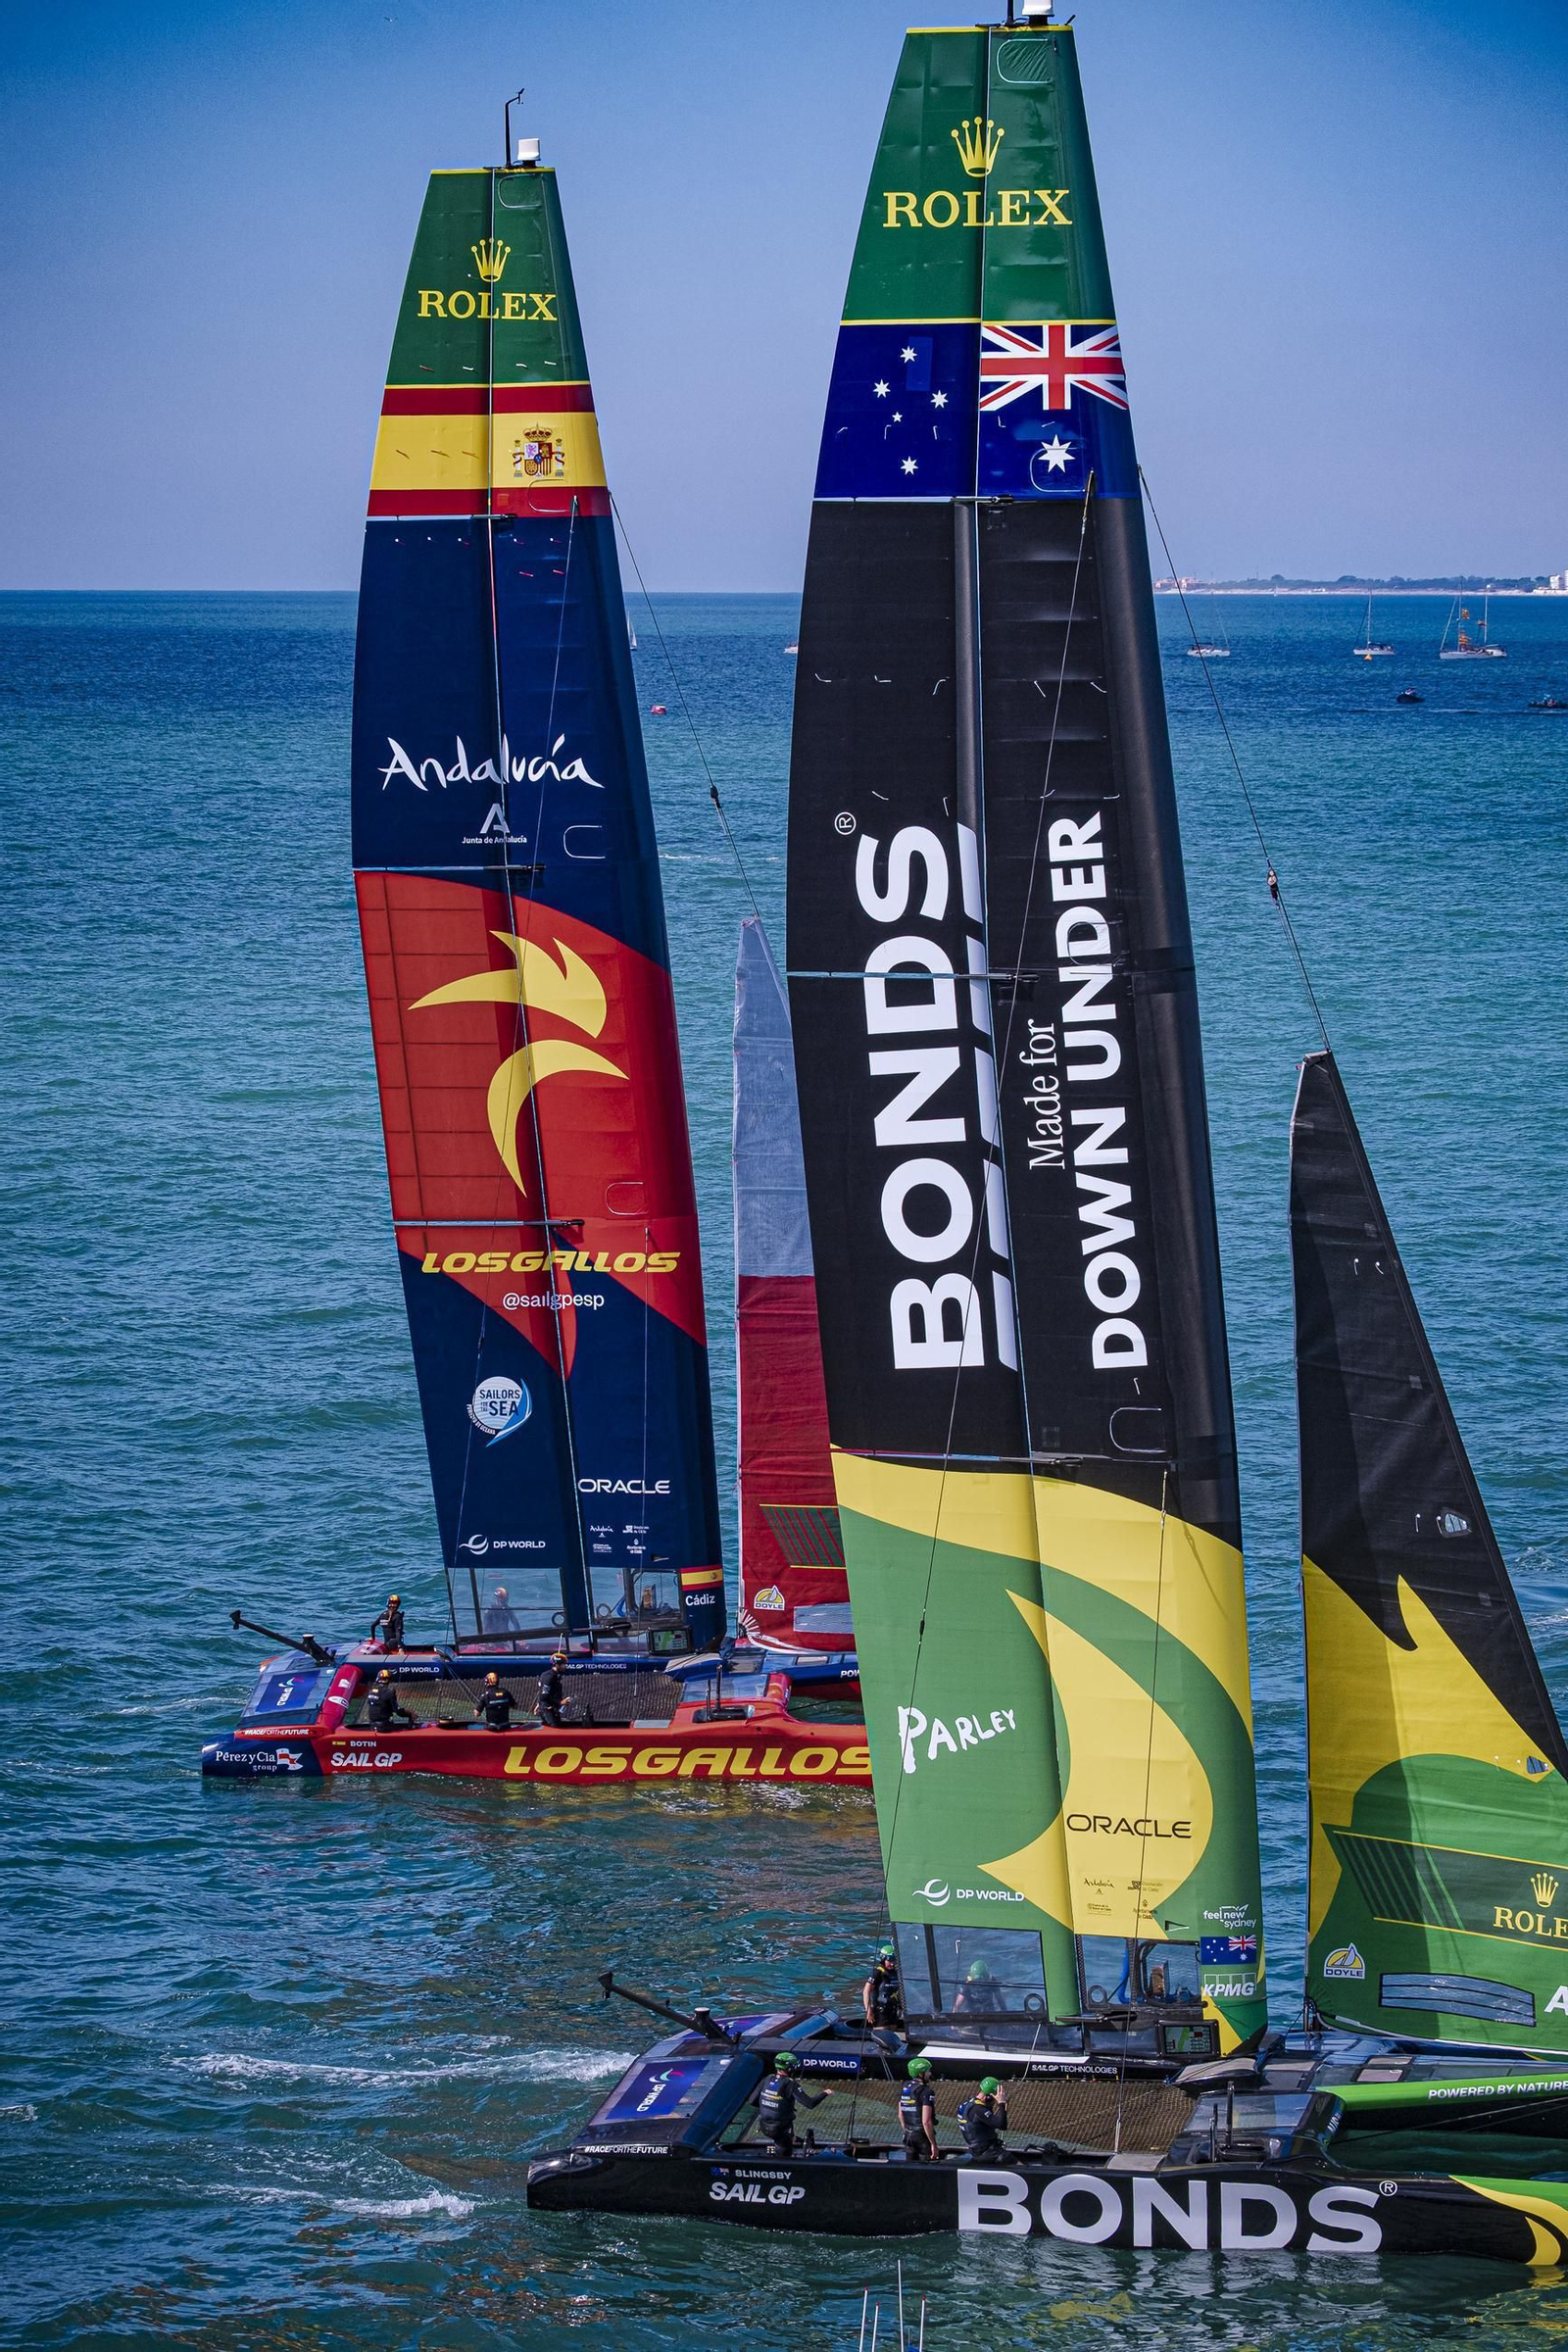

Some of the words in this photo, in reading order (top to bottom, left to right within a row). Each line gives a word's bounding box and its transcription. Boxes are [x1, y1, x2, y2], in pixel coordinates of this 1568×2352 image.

[883, 189, 1072, 227] ROLEX
[417, 290, 557, 320] ROLEX
[377, 733, 605, 791] Andalucía
[1048, 811, 1121, 1080] UNDER
[1019, 1018, 1055, 1065] for
[856, 824, 986, 1369] BONDS
[1029, 1073, 1065, 1169] Made
[1073, 1107, 1148, 1369] DOWN
[503, 1291, 605, 1310] @sailgpesp
[479, 1389, 520, 1399] SAILORS
[489, 1400, 518, 1416] SEA
[577, 1479, 670, 1494] ORACLE
[685, 1593, 715, 1606] Cádiz
[1066, 1814, 1192, 1838] ORACLE
[956, 1889, 973, 1899] DP
[976, 1889, 1024, 1902] WORLD
[1203, 1910, 1222, 1919] feel
[1224, 1919, 1256, 1930] sydney
[1202, 1982, 1254, 1996] KPMG
[818, 2060, 858, 2069] WORLD
[1059, 2065, 1118, 2074] TECHNOLOGIES
[1428, 2085, 1494, 2099] POWERED
[1497, 2083, 1514, 2094] BY
[584, 2145, 668, 2154] #RACEFORTHEFUTURE
[735, 2169, 792, 2180] SLINGSBY
[956, 2169, 1383, 2253] BONDS
